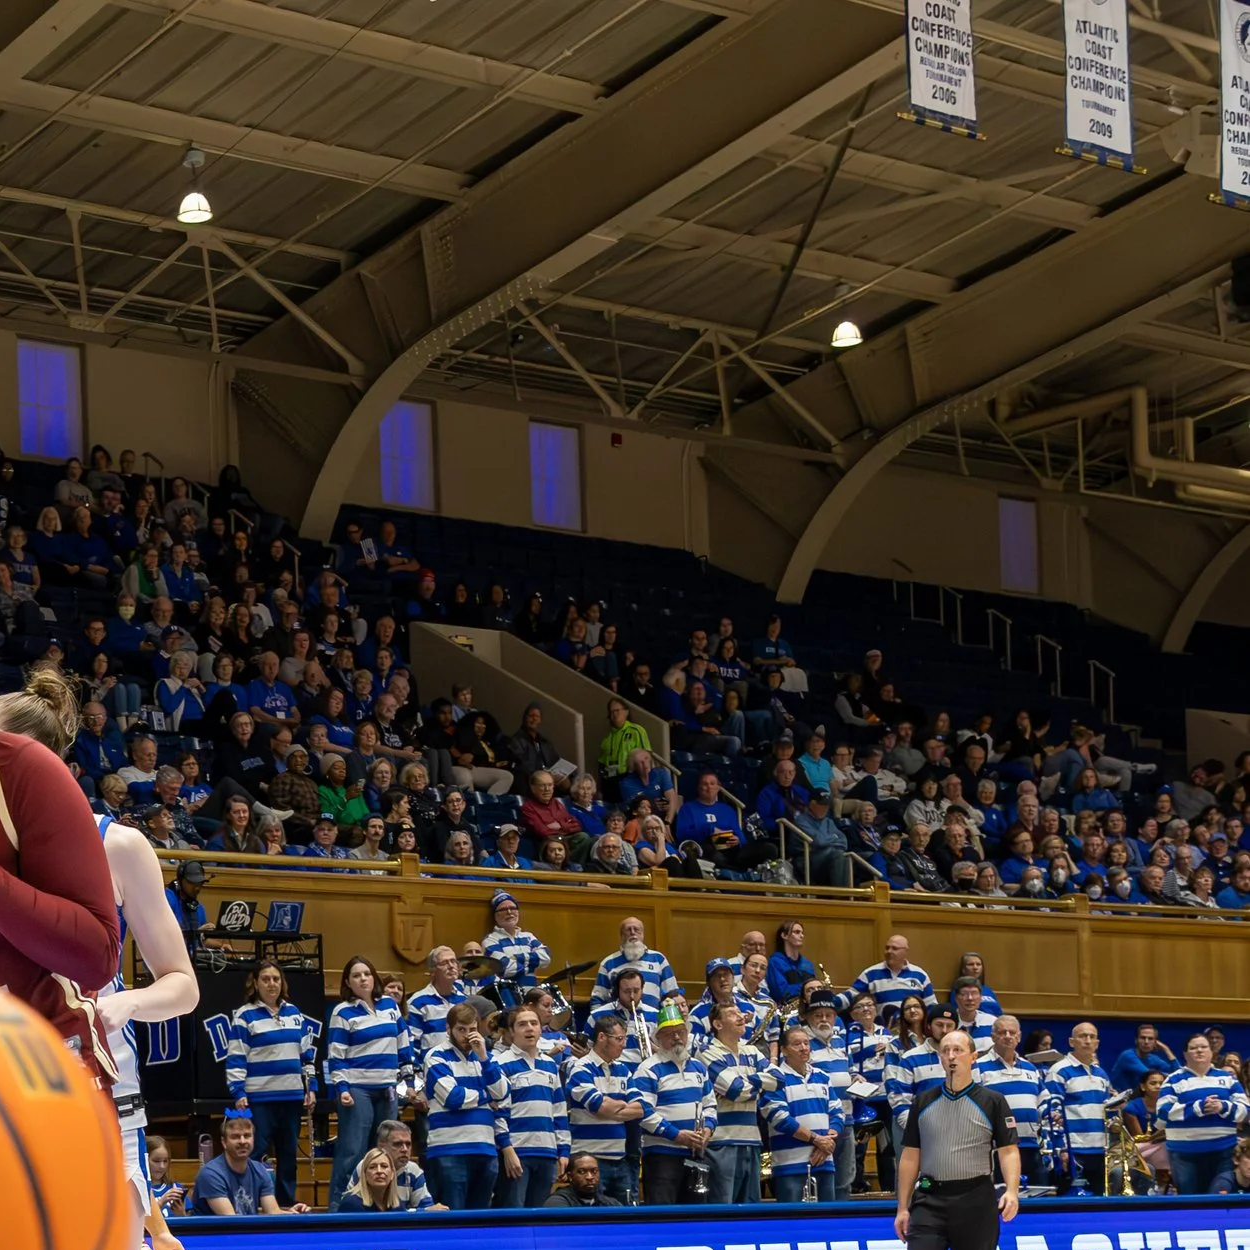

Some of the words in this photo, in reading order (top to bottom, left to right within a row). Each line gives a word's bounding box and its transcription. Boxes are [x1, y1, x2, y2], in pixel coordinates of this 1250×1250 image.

[925, 2, 956, 23] COAST
[911, 16, 972, 48] CONFERENCE
[1075, 19, 1119, 43] ATLANTIC
[915, 36, 971, 66] CHAMPIONS
[1085, 39, 1114, 60] COAST
[1068, 55, 1127, 84] CONFERENCE
[1070, 74, 1126, 102] CHAMPIONS
[1089, 118, 1113, 139] 2009
